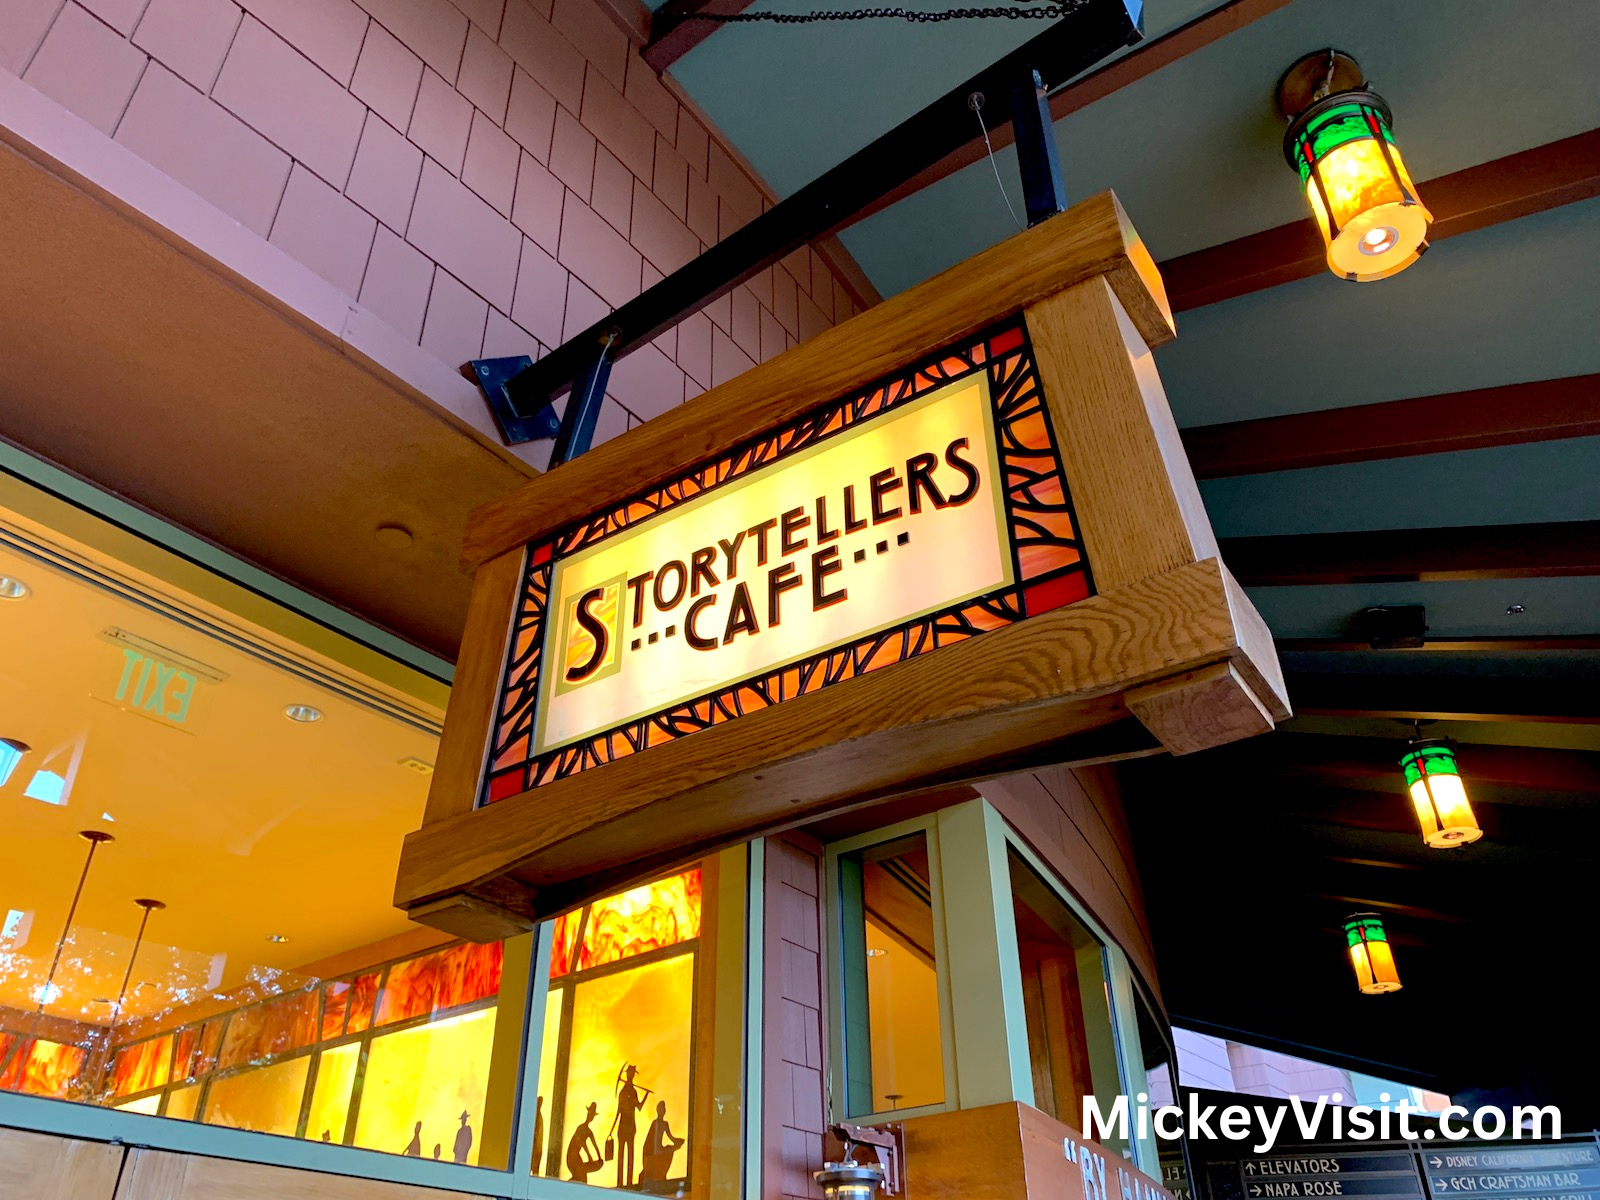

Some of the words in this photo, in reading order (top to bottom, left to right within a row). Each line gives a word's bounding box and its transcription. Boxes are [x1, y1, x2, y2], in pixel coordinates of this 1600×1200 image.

[565, 437, 980, 682] STORYTELLERS
[1260, 1158, 1340, 1175] ELEVATORS
[1446, 1156, 1478, 1168] DISNEY
[1540, 1150, 1595, 1165] ENTURE
[1265, 1182, 1300, 1197] NAPA
[1303, 1180, 1343, 1196] ROSE
[1451, 1177, 1477, 1191] GCH
[1480, 1174, 1552, 1191] CRAFTSMAN
[1554, 1172, 1581, 1187] BAR
